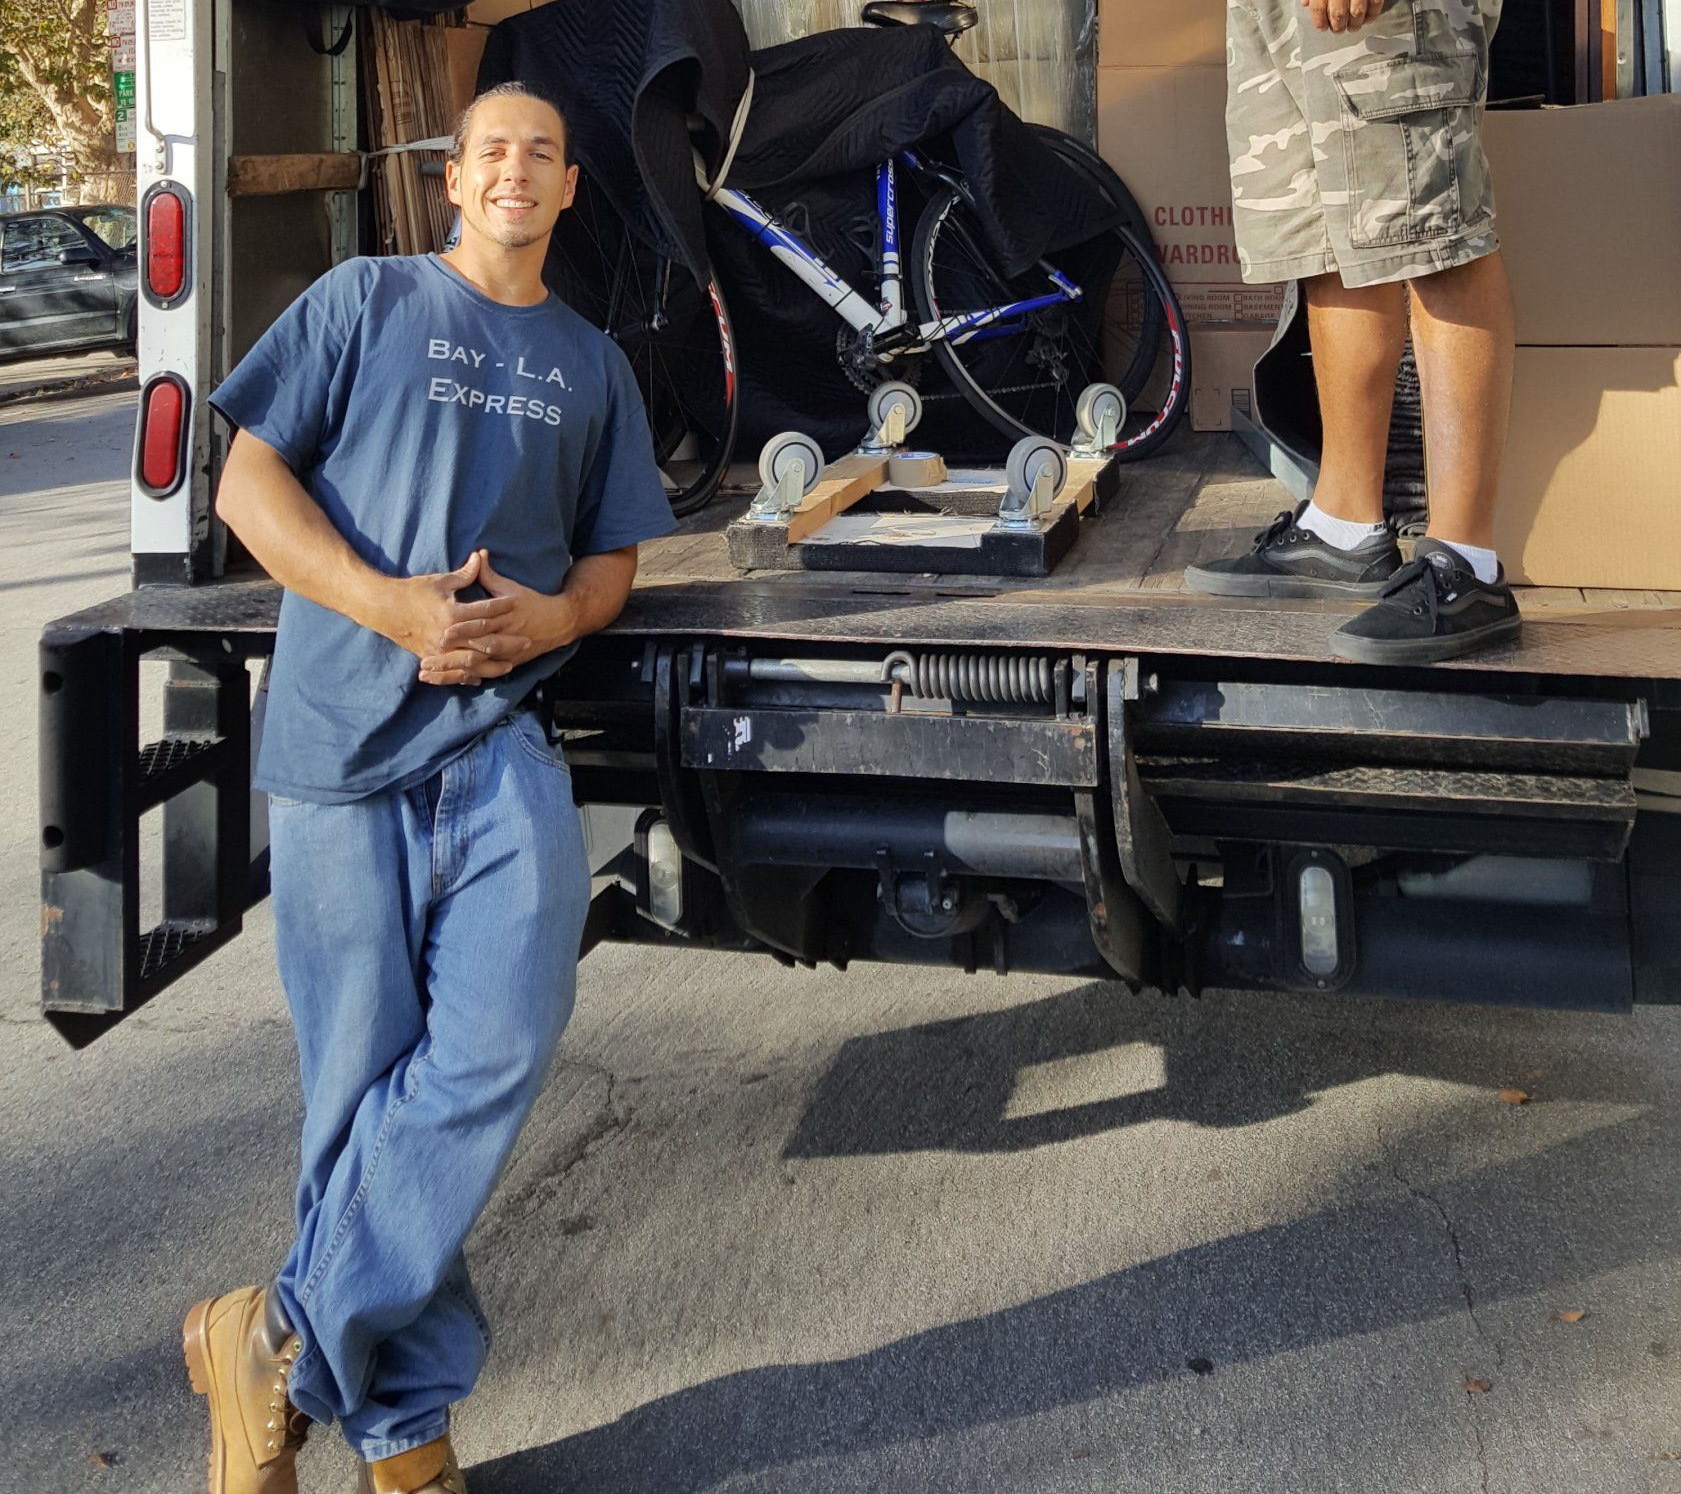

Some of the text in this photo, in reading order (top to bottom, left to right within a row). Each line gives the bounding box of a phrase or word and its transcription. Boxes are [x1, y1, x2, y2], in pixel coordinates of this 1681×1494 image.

[428, 339, 486, 368] BAY
[517, 357, 573, 392] L.A.
[428, 377, 562, 426] EXPRESS
